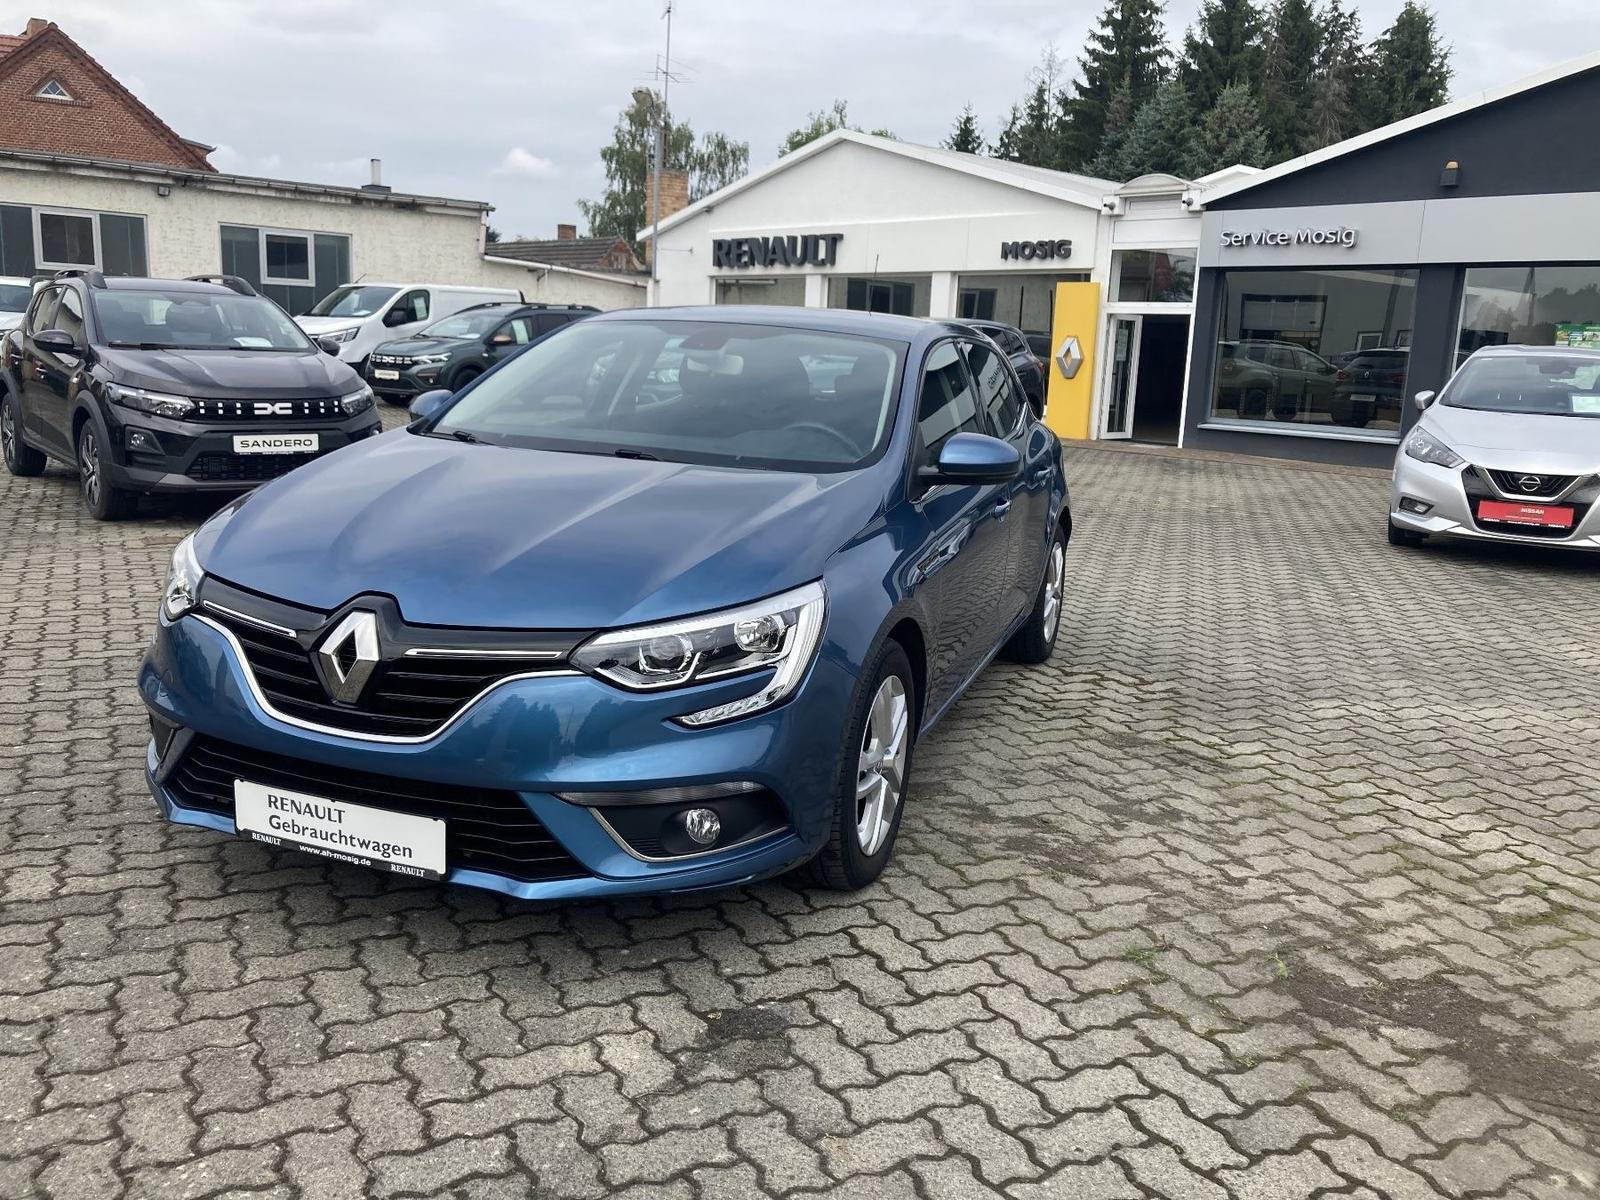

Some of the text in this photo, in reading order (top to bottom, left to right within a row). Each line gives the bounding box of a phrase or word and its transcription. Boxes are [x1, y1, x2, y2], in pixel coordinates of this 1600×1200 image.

[1219, 229, 1358, 248] Service Mosig
[712, 233, 844, 268] RENAULT
[1000, 239, 1072, 261] MOSIG
[240, 439, 313, 448] SANDERO
[1520, 507, 1545, 515] NISSAN
[267, 794, 346, 824] RENAULT
[251, 832, 282, 846] RENAULT
[268, 814, 413, 859] Gebrauchtwagen
[299, 844, 372, 866] www.ah-mosig.de
[390, 863, 426, 878] RENAULT
